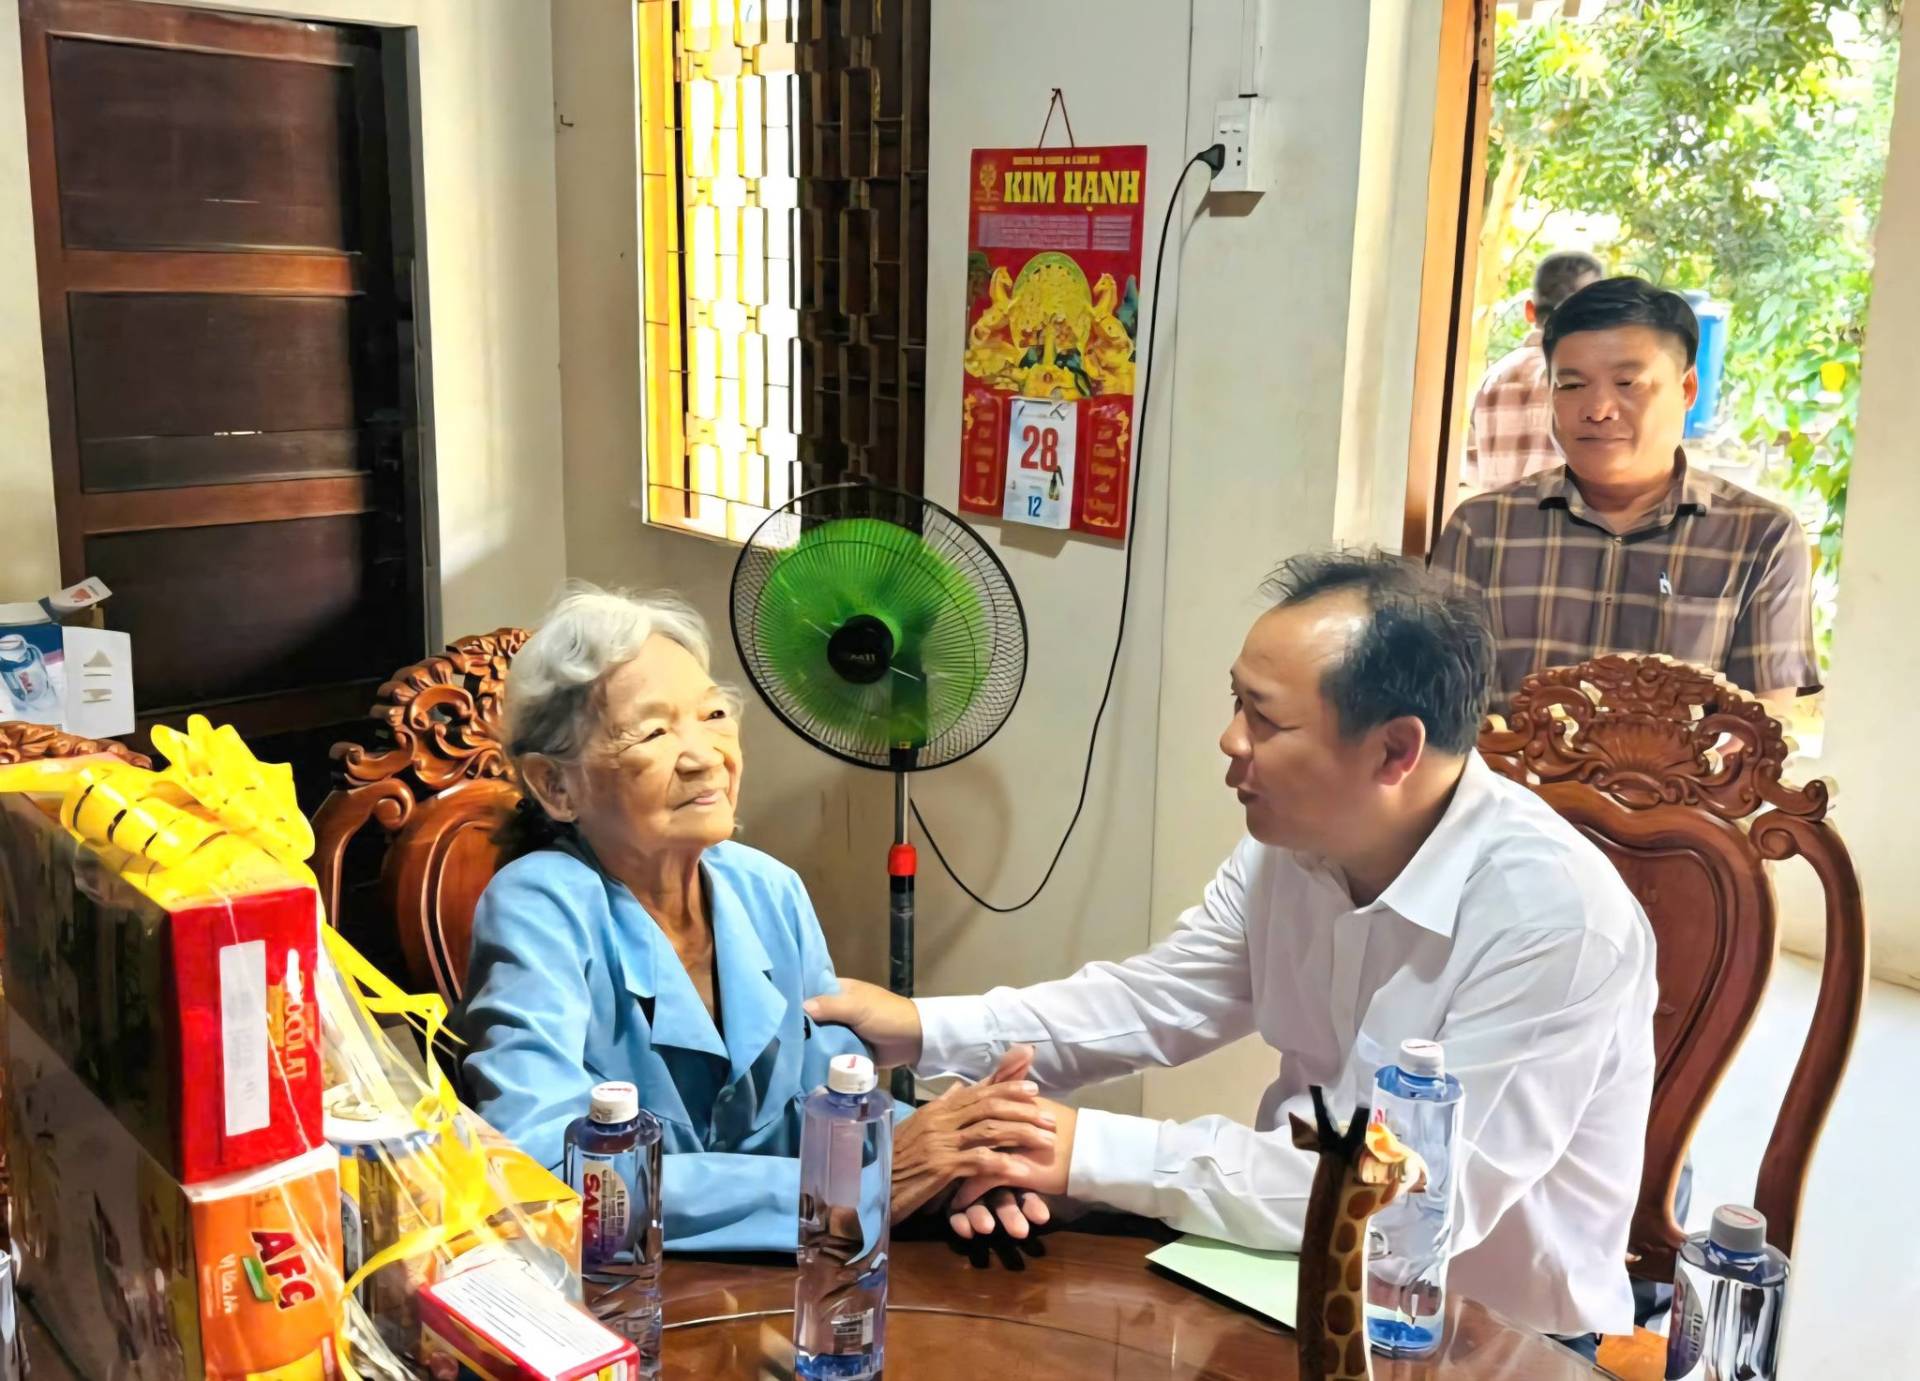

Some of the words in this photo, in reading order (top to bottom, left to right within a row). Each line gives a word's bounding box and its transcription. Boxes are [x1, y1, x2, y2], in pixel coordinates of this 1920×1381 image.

[1003, 171, 1057, 203] KIM
[1020, 425, 1060, 473] 28
[1027, 495, 1043, 518] 12
[250, 1231, 316, 1310] AFC
